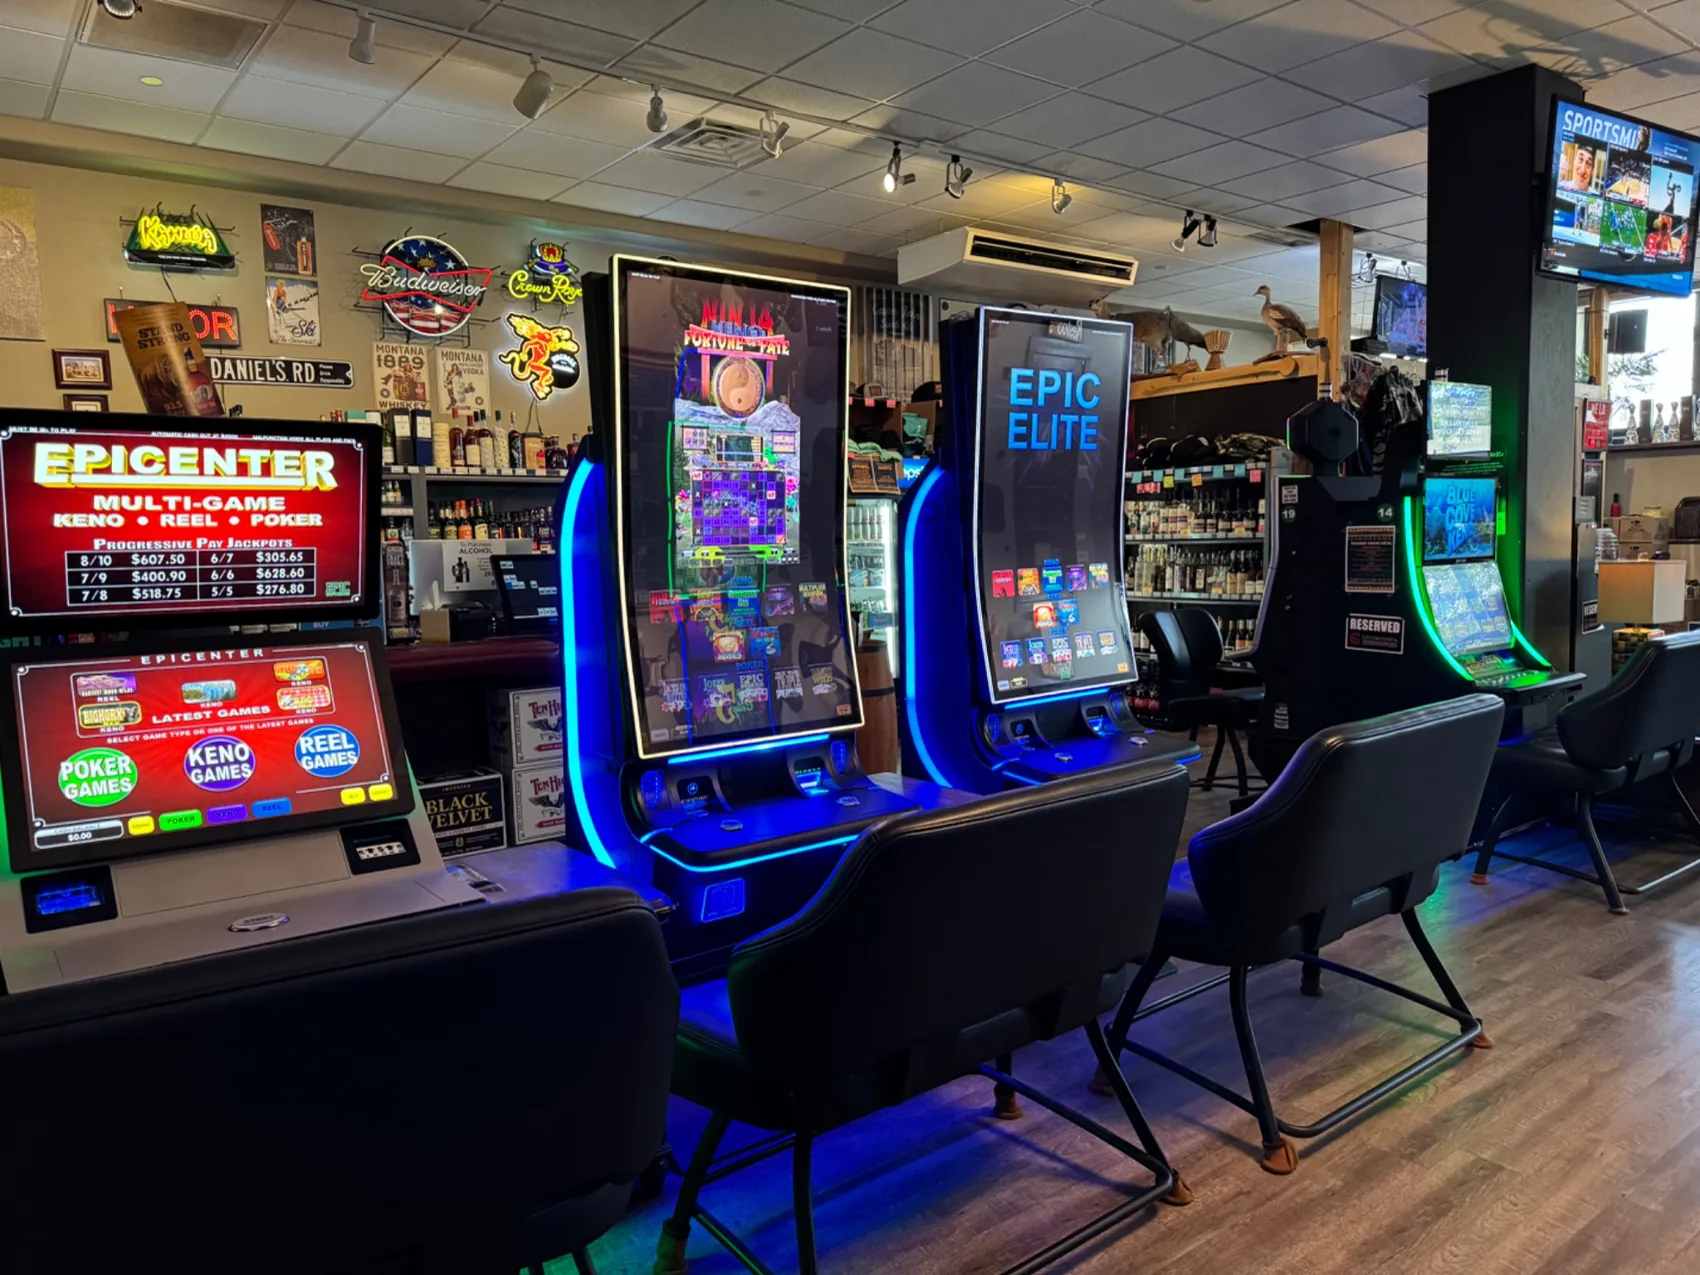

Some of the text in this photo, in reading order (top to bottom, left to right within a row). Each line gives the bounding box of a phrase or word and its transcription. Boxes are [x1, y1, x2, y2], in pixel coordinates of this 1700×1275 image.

[1562, 110, 1641, 150] SPORTSMI
[360, 264, 487, 296] Budweiser
[508, 270, 583, 304] Crown Roya
[702, 298, 773, 334] NINJA
[291, 319, 317, 338] Ski
[711, 321, 767, 337] KENO
[376, 344, 424, 356] MONTANA
[684, 330, 744, 350] FORTUNE
[760, 340, 790, 356] FATE
[377, 354, 424, 370] 1889
[441, 351, 483, 363] MONTANA
[292, 362, 315, 383] RD
[463, 367, 484, 375] VODKA
[1010, 368, 1100, 409] EPIC
[379, 401, 427, 409] WHISKEY
[1008, 412, 1099, 450] ELITE
[34, 442, 338, 491] EPICENTER
[903, 466, 924, 481] epsi
[93, 495, 286, 511] MULTI-GAME
[1447, 484, 1475, 505] BLUE
[53, 514, 323, 528] KENO REEL POKER
[1282, 510, 1295, 519] 19
[1378, 507, 1393, 518] 14
[1446, 502, 1476, 531] COVE
[93, 537, 293, 550] PROGRESSIVE PAY JACKPOTS
[80, 551, 304, 567] 8/10 $607.50 6/7 $305.65
[81, 567, 305, 584] 7/9 $400.90 6/6 $628.60
[81, 583, 305, 602] 7/8 $518.75 5/5 $276.80
[1350, 618, 1400, 633] RESERVED
[141, 648, 264, 665] EPICENTER
[736, 661, 764, 670] POKER
[740, 673, 764, 684] EPIC
[152, 706, 271, 724] LATEST GAMES
[528, 701, 549, 719] TEN
[100, 725, 125, 733] KENO
[107, 736, 140, 744] SELECT
[143, 733, 167, 741] GAME
[257, 721, 285, 729] LATEST
[287, 718, 314, 726] GAMES
[299, 732, 355, 754] REEL
[188, 743, 249, 767] KENO
[301, 751, 358, 770] GAMES
[60, 755, 132, 781] POKER
[190, 763, 253, 784] GAMES
[64, 777, 133, 800] GAMES
[530, 778, 550, 795] TEN
[262, 804, 281, 812] REEL
[426, 792, 488, 814] BLACK
[167, 815, 195, 824] POKER
[216, 809, 238, 818] KENO
[68, 831, 92, 842] $0.00
